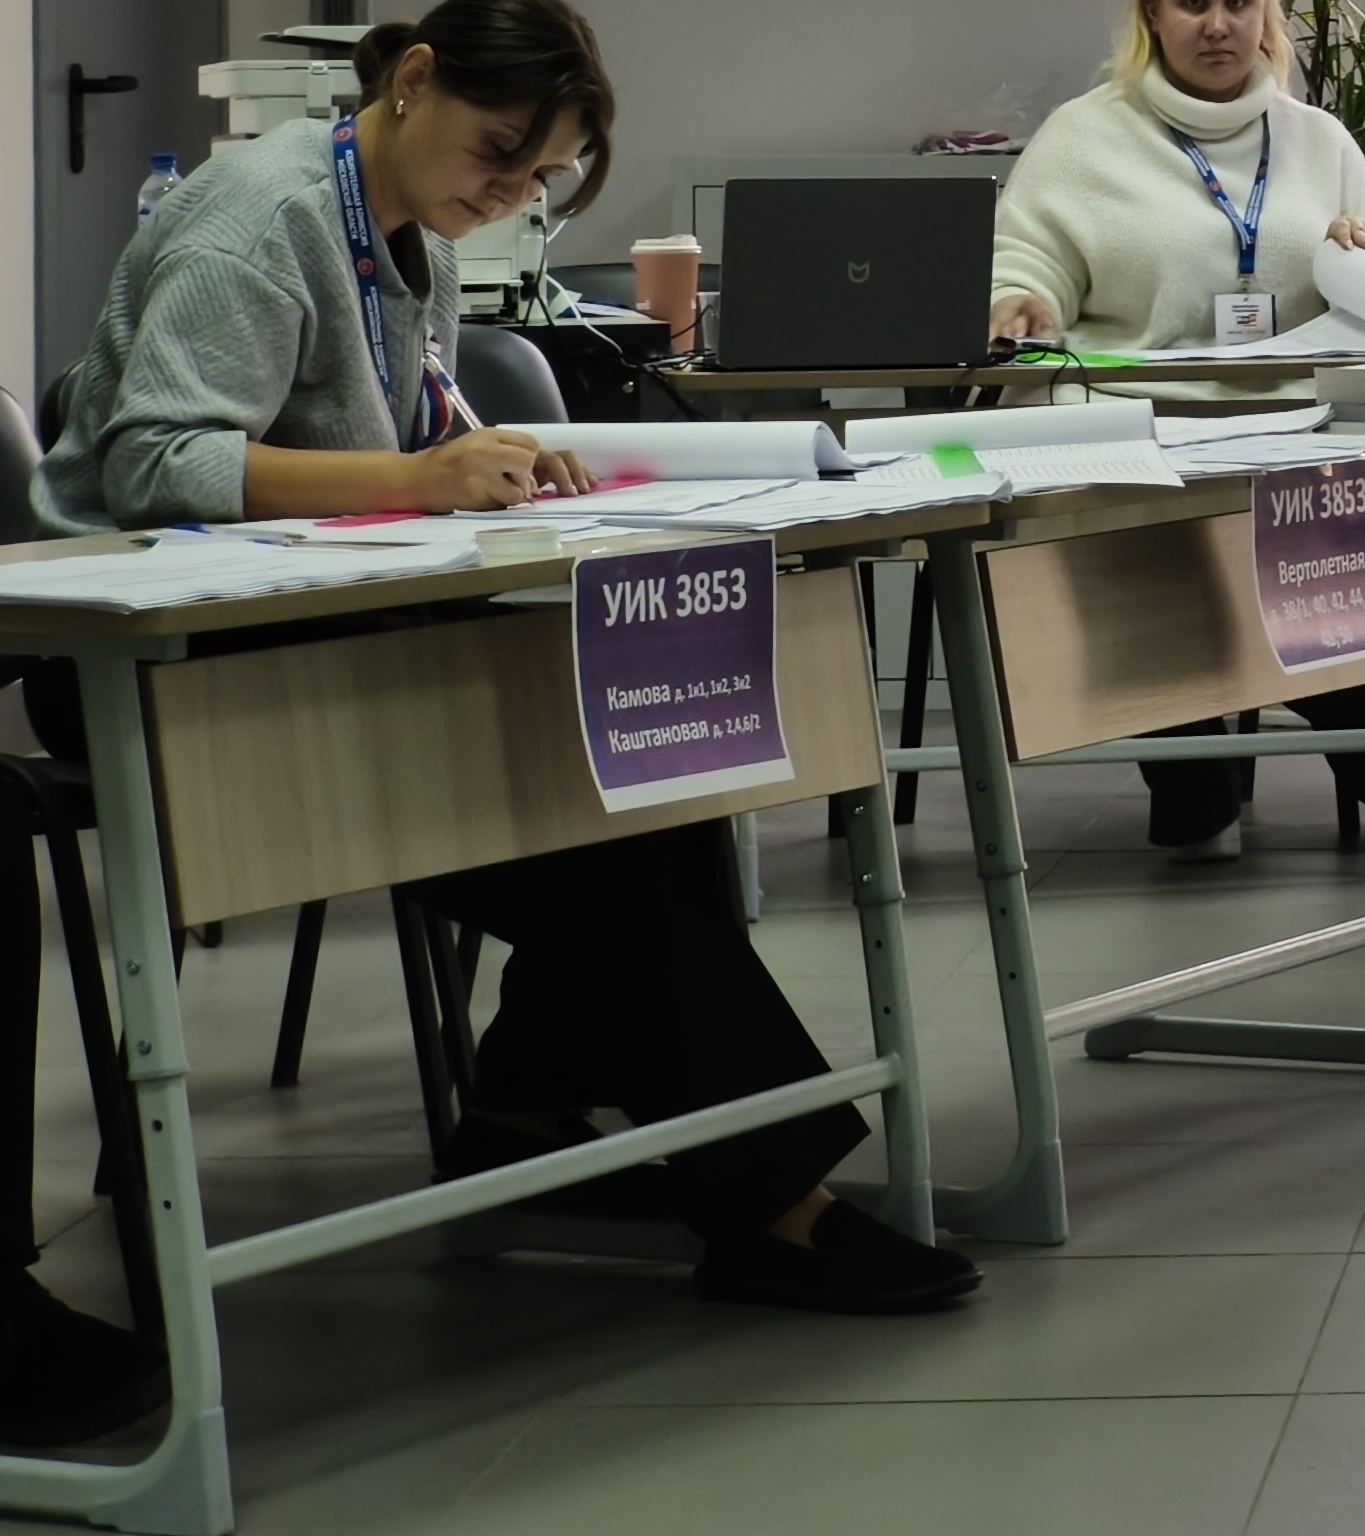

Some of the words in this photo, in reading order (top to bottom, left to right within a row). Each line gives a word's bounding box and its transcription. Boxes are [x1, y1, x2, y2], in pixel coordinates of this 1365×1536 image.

[1271, 486, 1314, 526] УИК
[1279, 552, 1365, 587] Вертолетная
[603, 577, 667, 627] УИК
[676, 568, 747, 617] 3853
[607, 684, 671, 711] Камова
[674, 688, 685, 703] д.
[608, 720, 709, 754] Каштановая
[713, 724, 723, 738] д.
